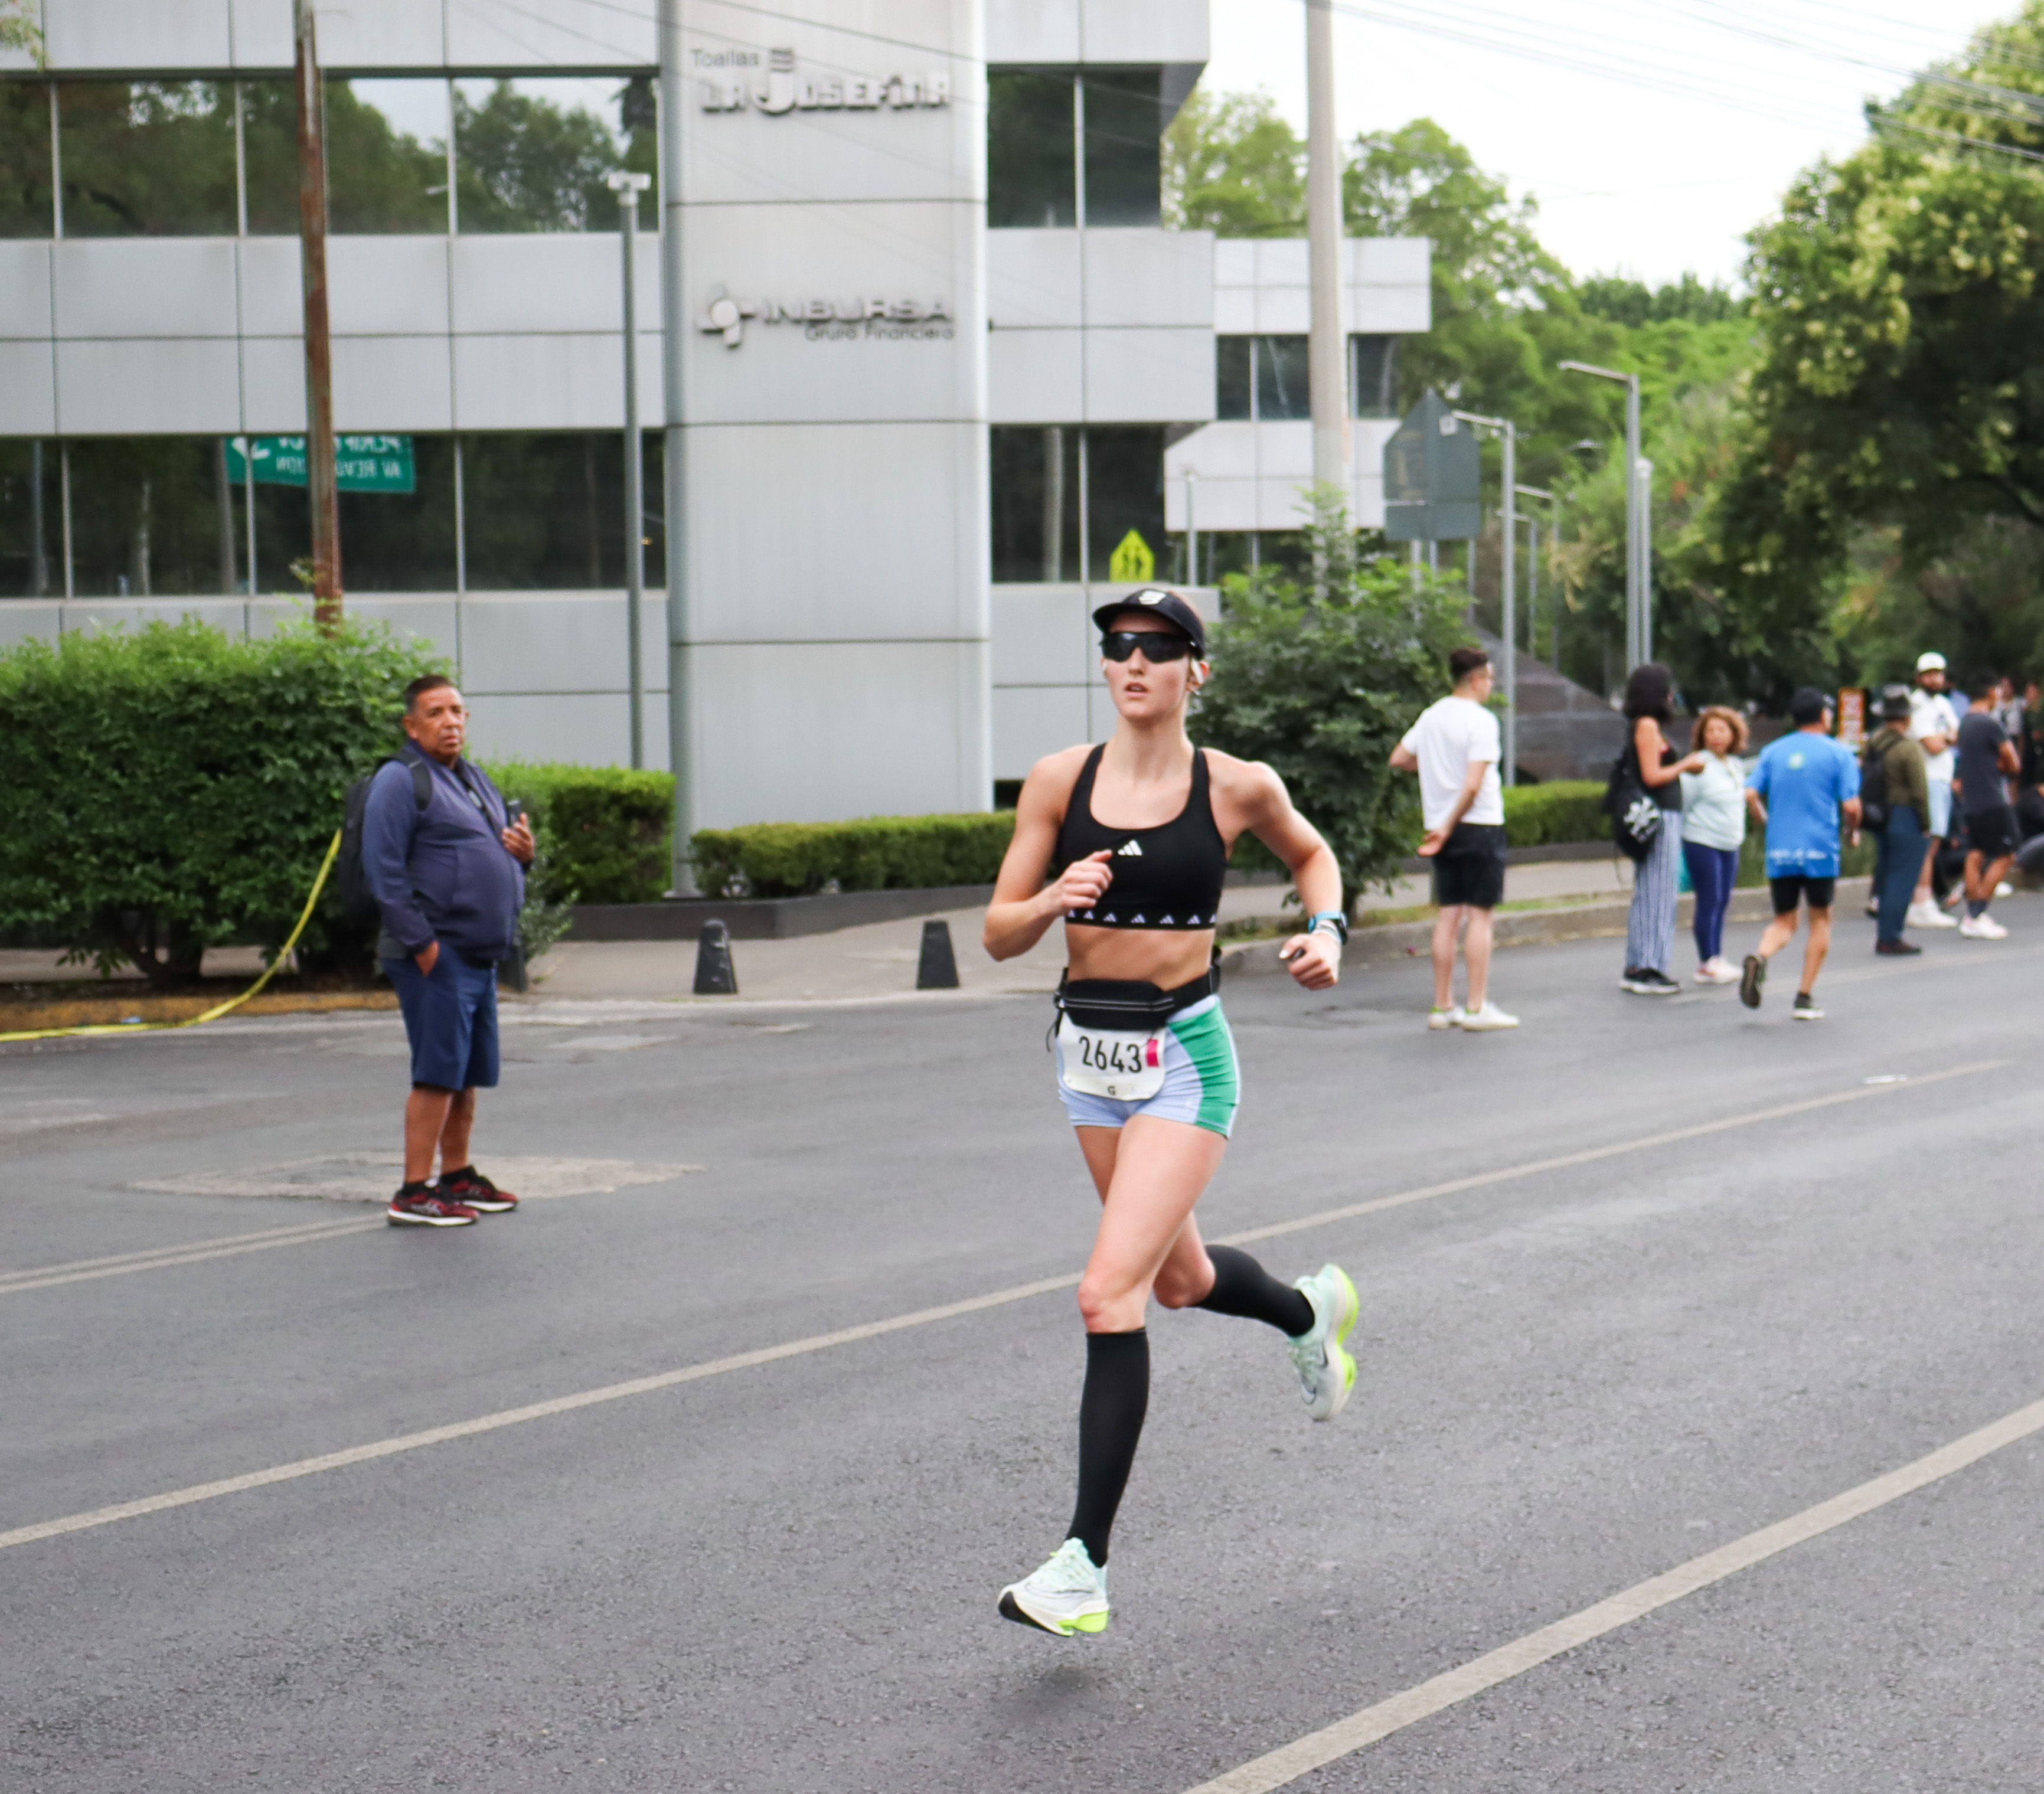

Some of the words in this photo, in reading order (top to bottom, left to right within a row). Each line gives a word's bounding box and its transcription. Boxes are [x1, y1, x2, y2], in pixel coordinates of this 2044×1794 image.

[691, 48, 759, 67] Toallas
[764, 296, 953, 323] INBURSA
[1079, 1035, 1142, 1073] 2643
[1108, 1085, 1116, 1095] G
